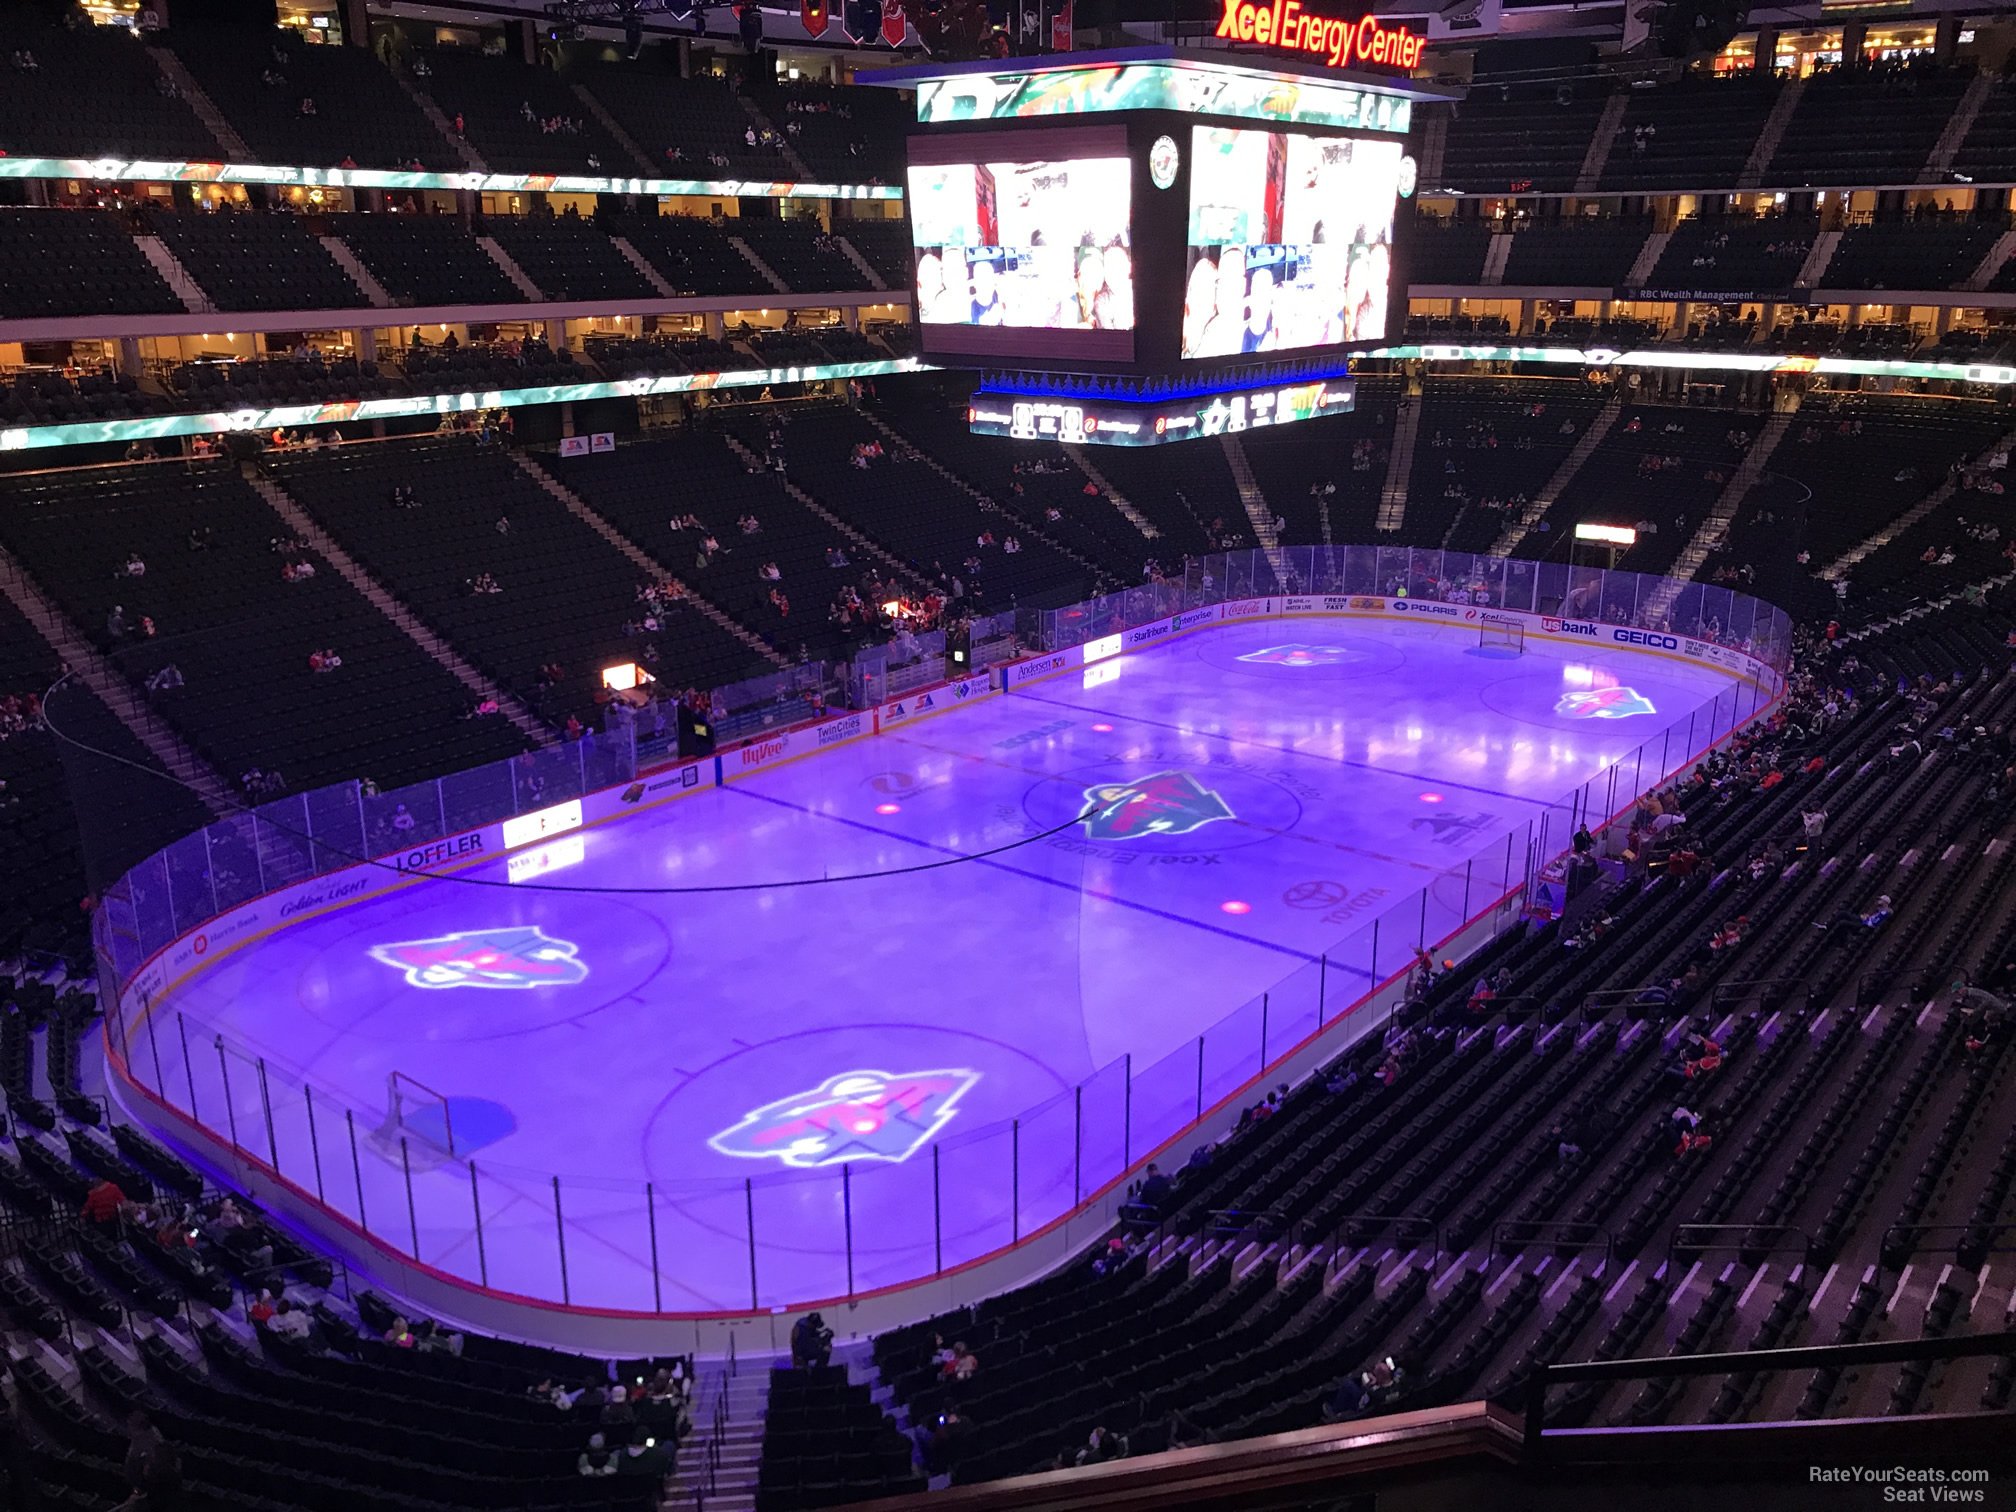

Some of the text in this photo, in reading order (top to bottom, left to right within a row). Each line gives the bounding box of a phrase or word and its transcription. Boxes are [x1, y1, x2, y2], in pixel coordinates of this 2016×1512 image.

[1217, 0, 1426, 68] Xcel Energy Center
[1640, 289, 1657, 299] RBC
[1660, 289, 1692, 299] Wealth
[1693, 290, 1754, 301] Management
[1411, 603, 1458, 616] POLARIS
[1480, 612, 1499, 621] Xcel
[1613, 629, 1678, 650] GEICO
[1018, 659, 1051, 677] Andersen
[396, 833, 482, 870] LOFFLER
[1149, 853, 1221, 866] Xcel
[280, 896, 324, 917] Golden
[329, 878, 369, 899] LIGHT
[1320, 887, 1392, 924] TOYOTA
